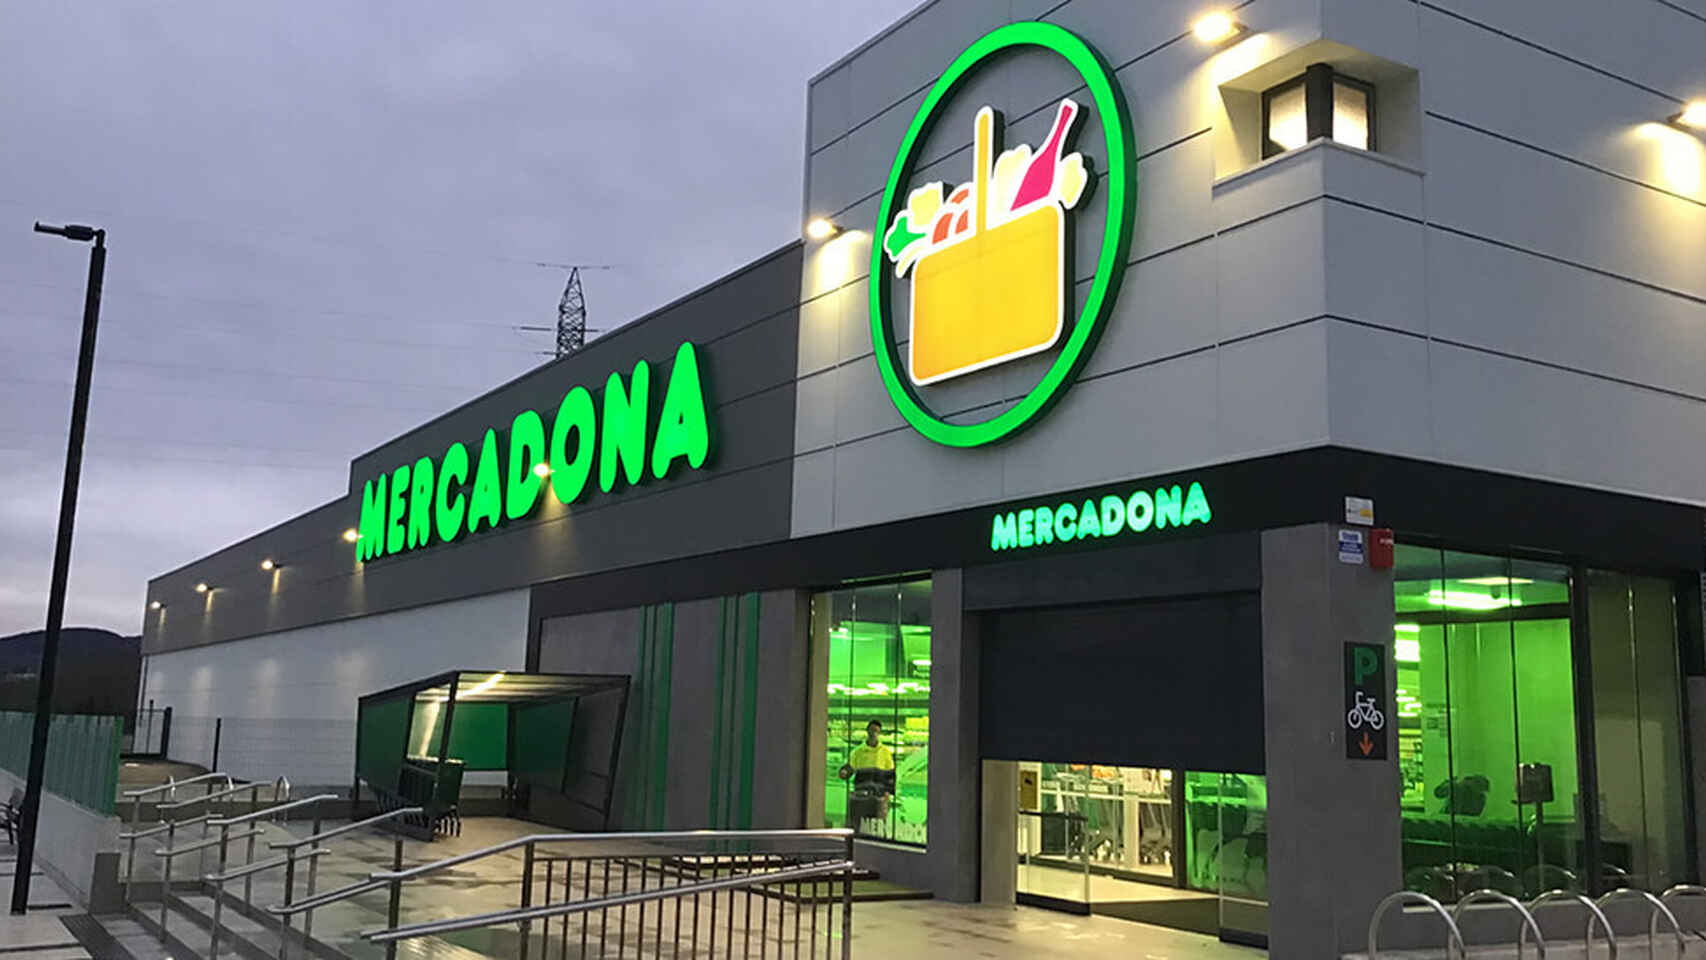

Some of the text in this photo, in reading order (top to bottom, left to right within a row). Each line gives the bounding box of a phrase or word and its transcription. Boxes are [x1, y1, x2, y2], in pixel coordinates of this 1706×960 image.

[355, 341, 709, 562] MERCADONA
[991, 481, 1212, 552] MERCADONA
[1354, 647, 1377, 685] P
